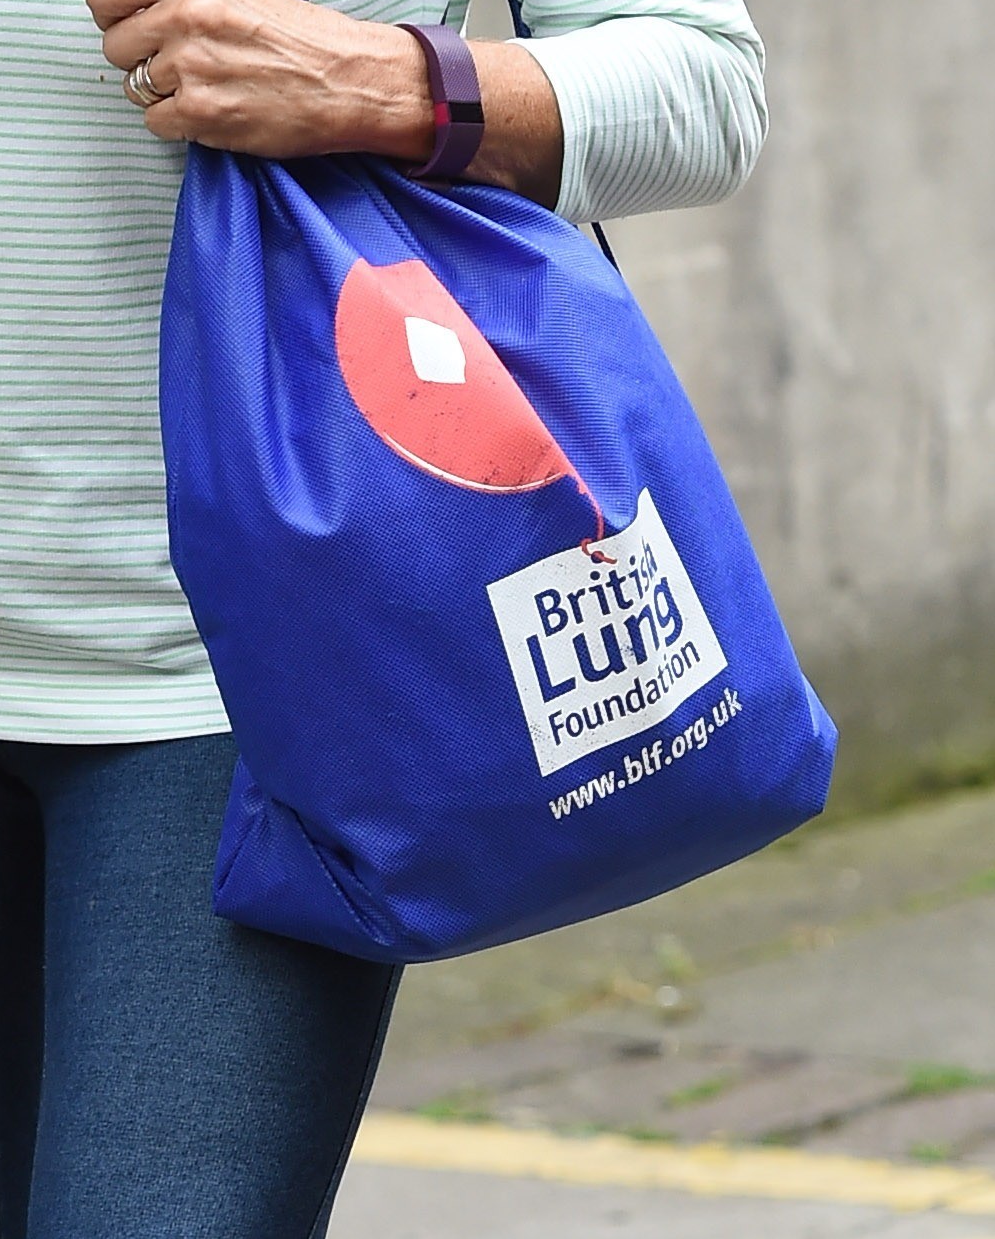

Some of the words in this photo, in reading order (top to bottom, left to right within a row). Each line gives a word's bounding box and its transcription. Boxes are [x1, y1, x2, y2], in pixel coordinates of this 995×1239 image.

[526, 575, 684, 704] Lung
[534, 535, 658, 638] British
[547, 639, 701, 747] Foundation
[548, 687, 743, 820] www.blf.org.uk
